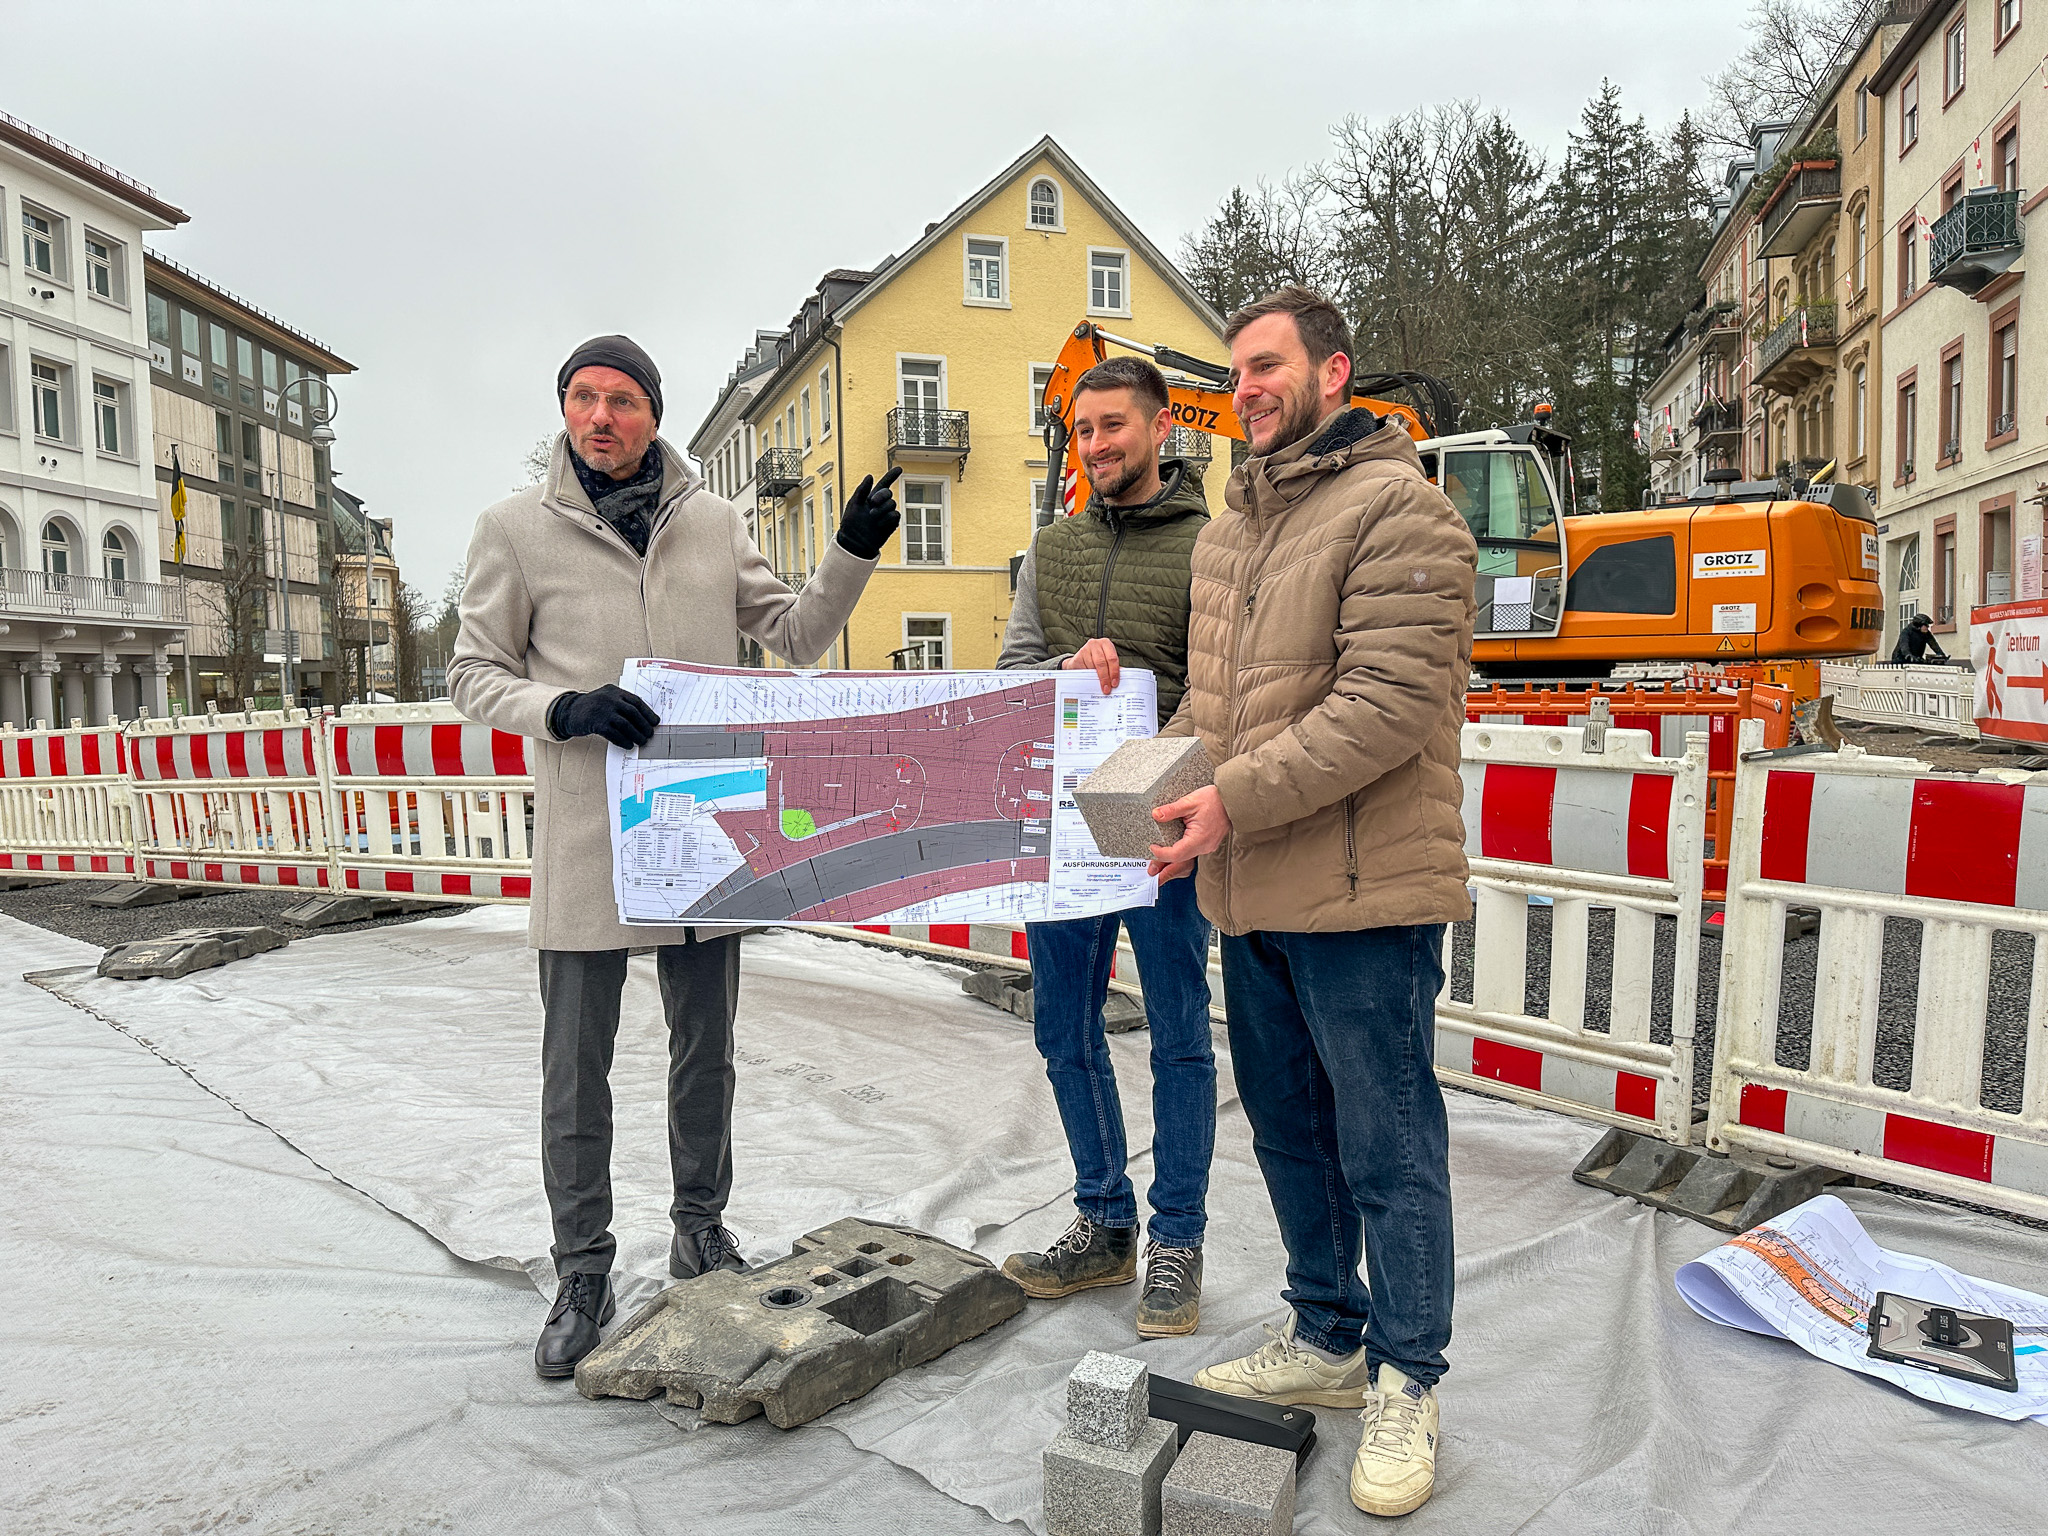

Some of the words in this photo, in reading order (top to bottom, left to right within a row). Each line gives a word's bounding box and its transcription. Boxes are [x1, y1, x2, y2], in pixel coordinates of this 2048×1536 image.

[1171, 402, 1220, 430] RÖTZ
[1704, 553, 1753, 566] GRÖTZ
[2005, 632, 2040, 652] Zentrum
